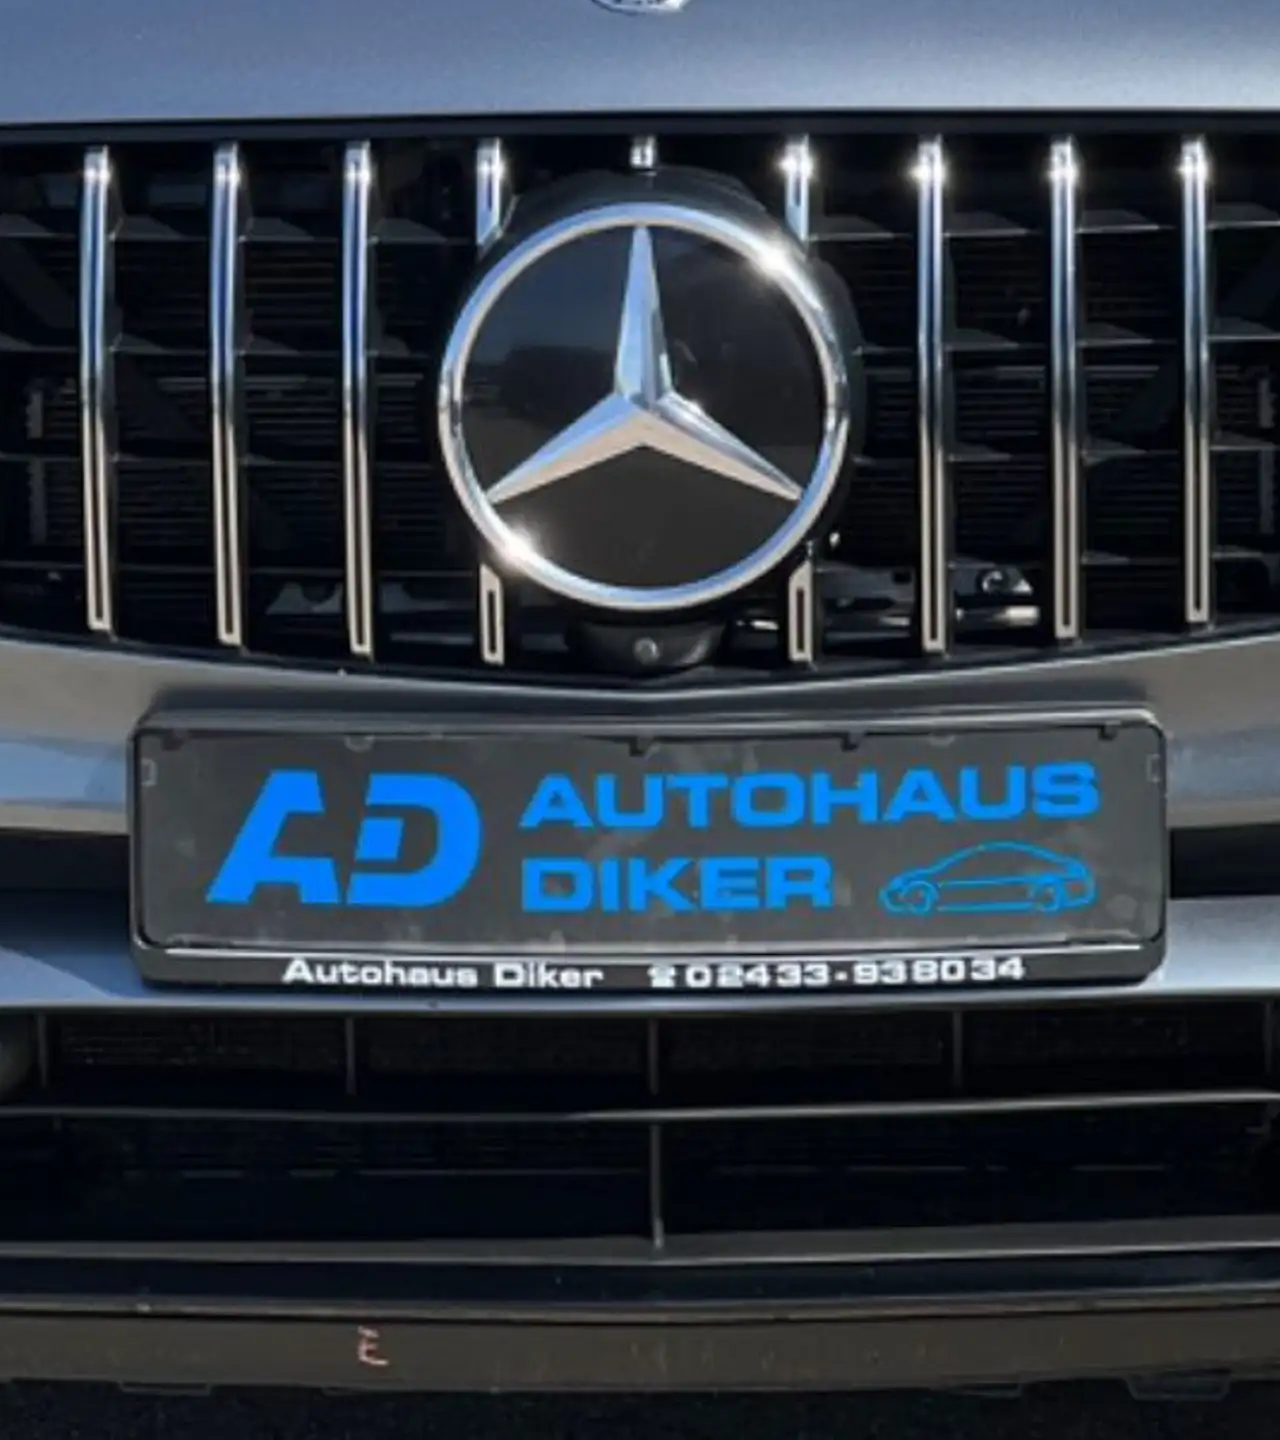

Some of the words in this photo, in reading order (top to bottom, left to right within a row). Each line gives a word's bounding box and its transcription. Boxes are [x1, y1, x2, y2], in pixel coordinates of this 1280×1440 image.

[519, 760, 1101, 830] AUTOHAUS
[204, 768, 483, 909] AD
[522, 856, 835, 913] DIKER
[282, 958, 479, 988] Autohaus
[494, 961, 605, 989] Diker
